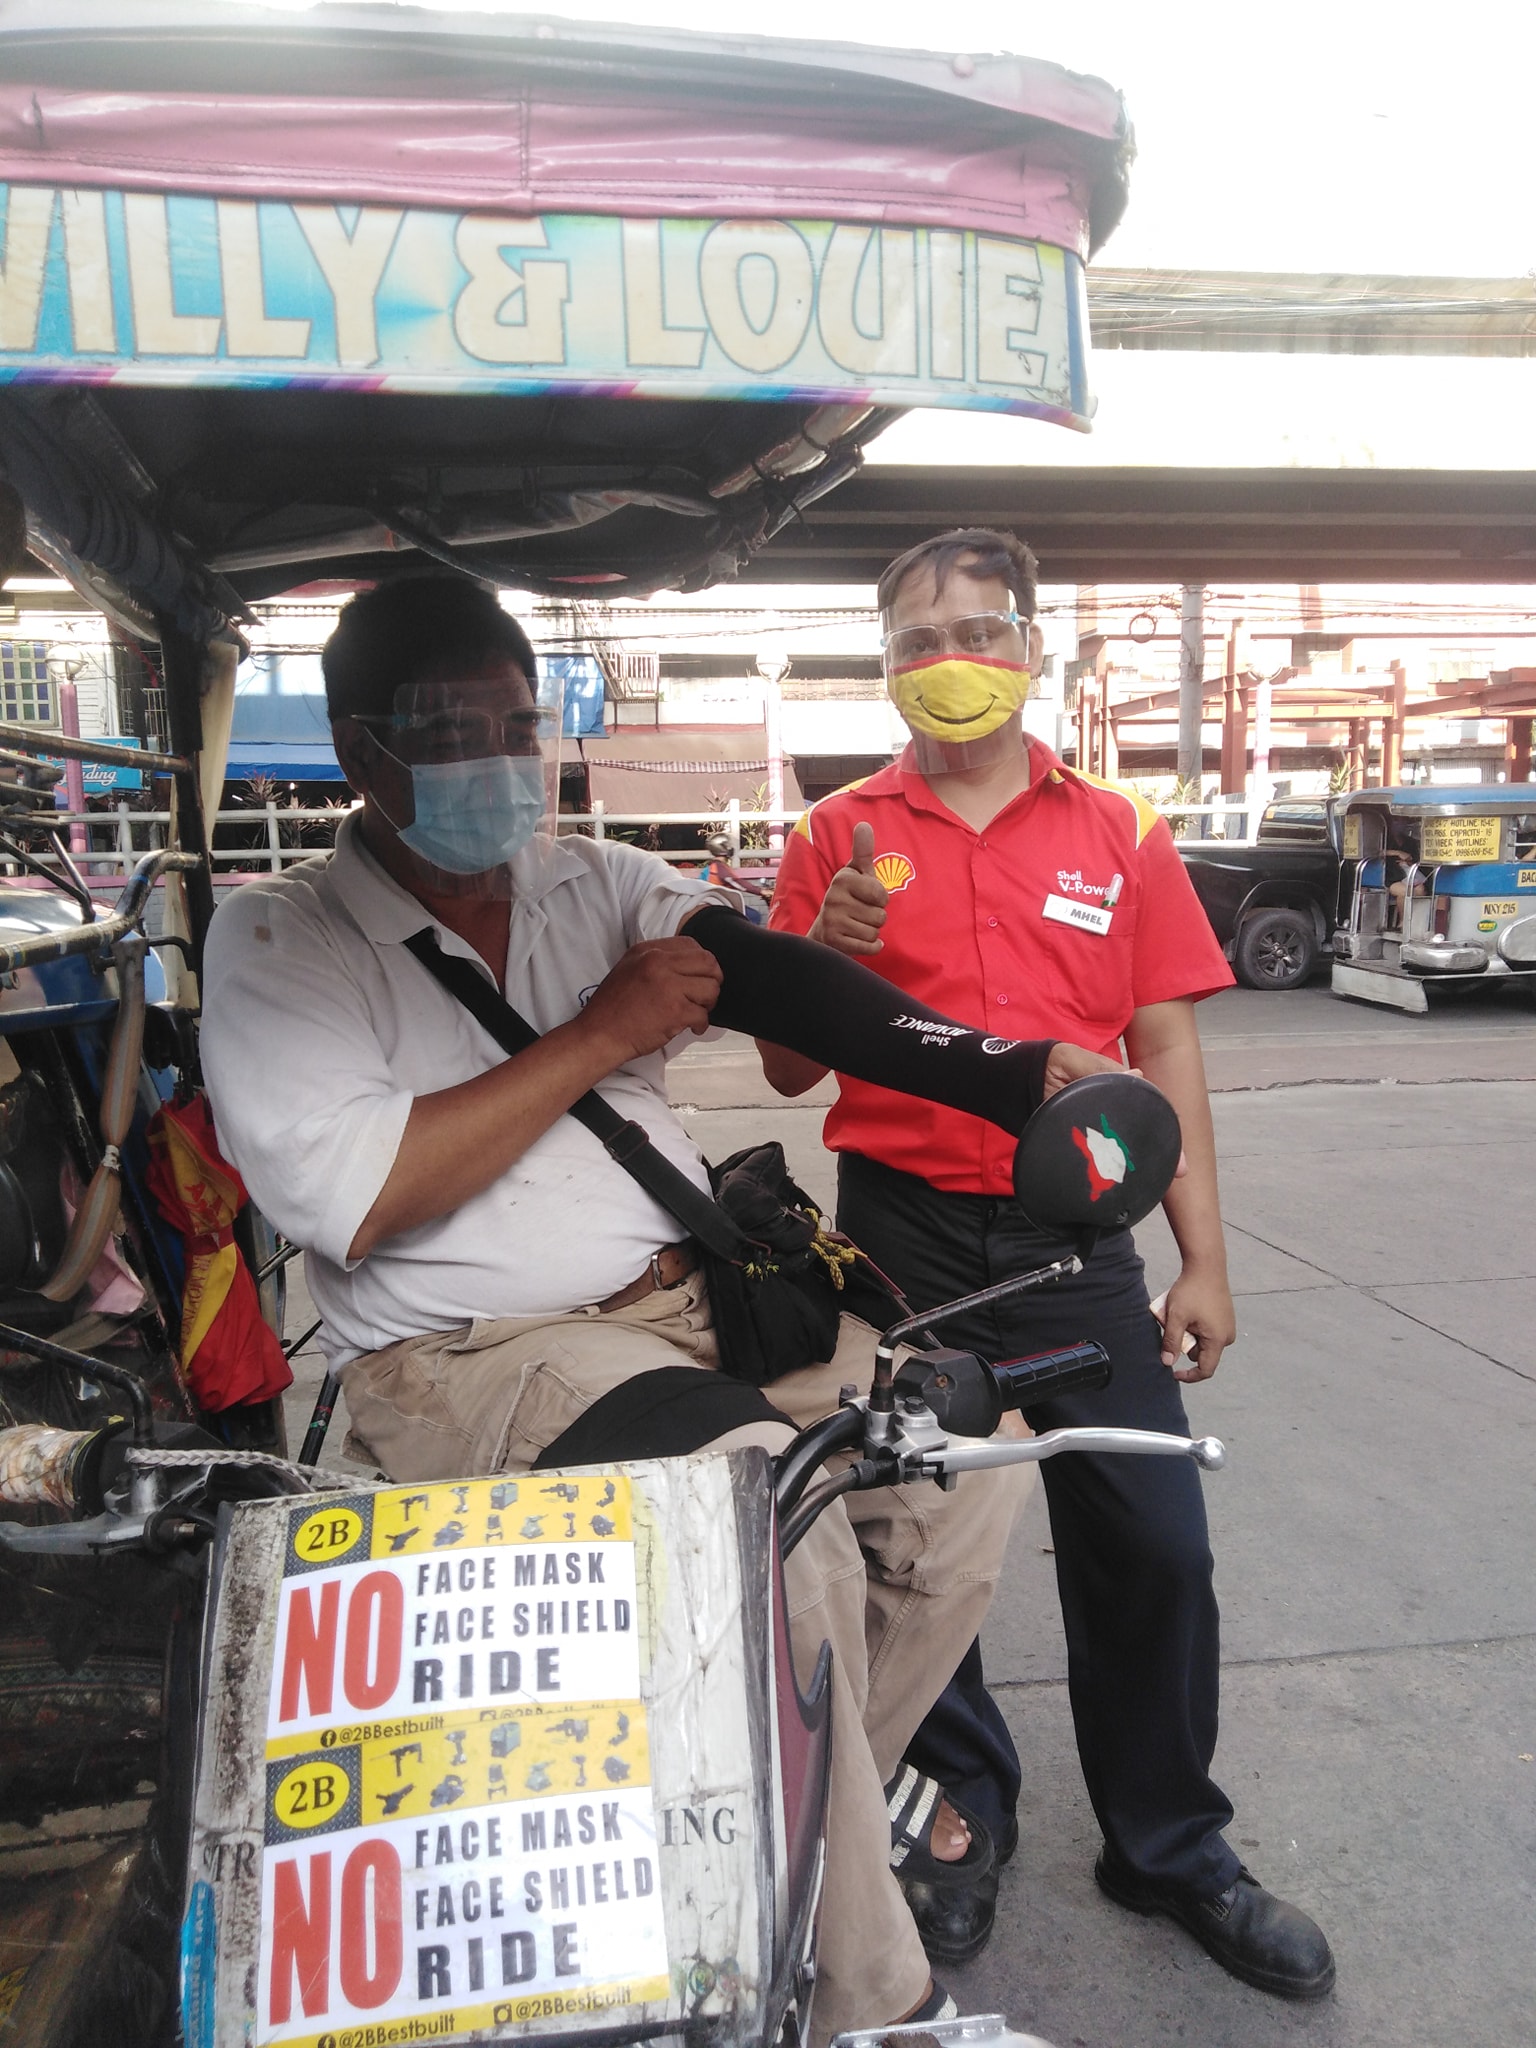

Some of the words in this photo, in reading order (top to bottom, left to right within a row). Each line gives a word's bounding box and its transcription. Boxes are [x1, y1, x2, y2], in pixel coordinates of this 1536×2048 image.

[621, 216, 1049, 389] LOUIE
[1057, 870, 1082, 881] Shell
[1070, 908, 1103, 926] MHEL
[888, 1014, 974, 1037] ADVANCE
[921, 1034, 951, 1047] Shell
[307, 1518, 351, 1550] 2B
[417, 1557, 498, 1596] FACE
[513, 1551, 607, 1588] MASK
[278, 1569, 406, 1724] NO
[414, 1609, 496, 1647] FACE
[513, 1598, 632, 1637] SHIELD
[411, 1647, 562, 1704] RIDE
[339, 1716, 445, 1744] @2BBestbuilt
[288, 1775, 337, 1815] 2B
[414, 1824, 503, 1869] FACE
[521, 1800, 624, 1853] MASK
[415, 1883, 503, 1931] FACE
[524, 1855, 655, 1914] SHIELD
[268, 1837, 404, 2027] NO
[416, 1921, 582, 2001] RIDE
[338, 2013, 456, 2047] @2BBestbuilt
[515, 1985, 632, 2020] @2BBestbuilt
